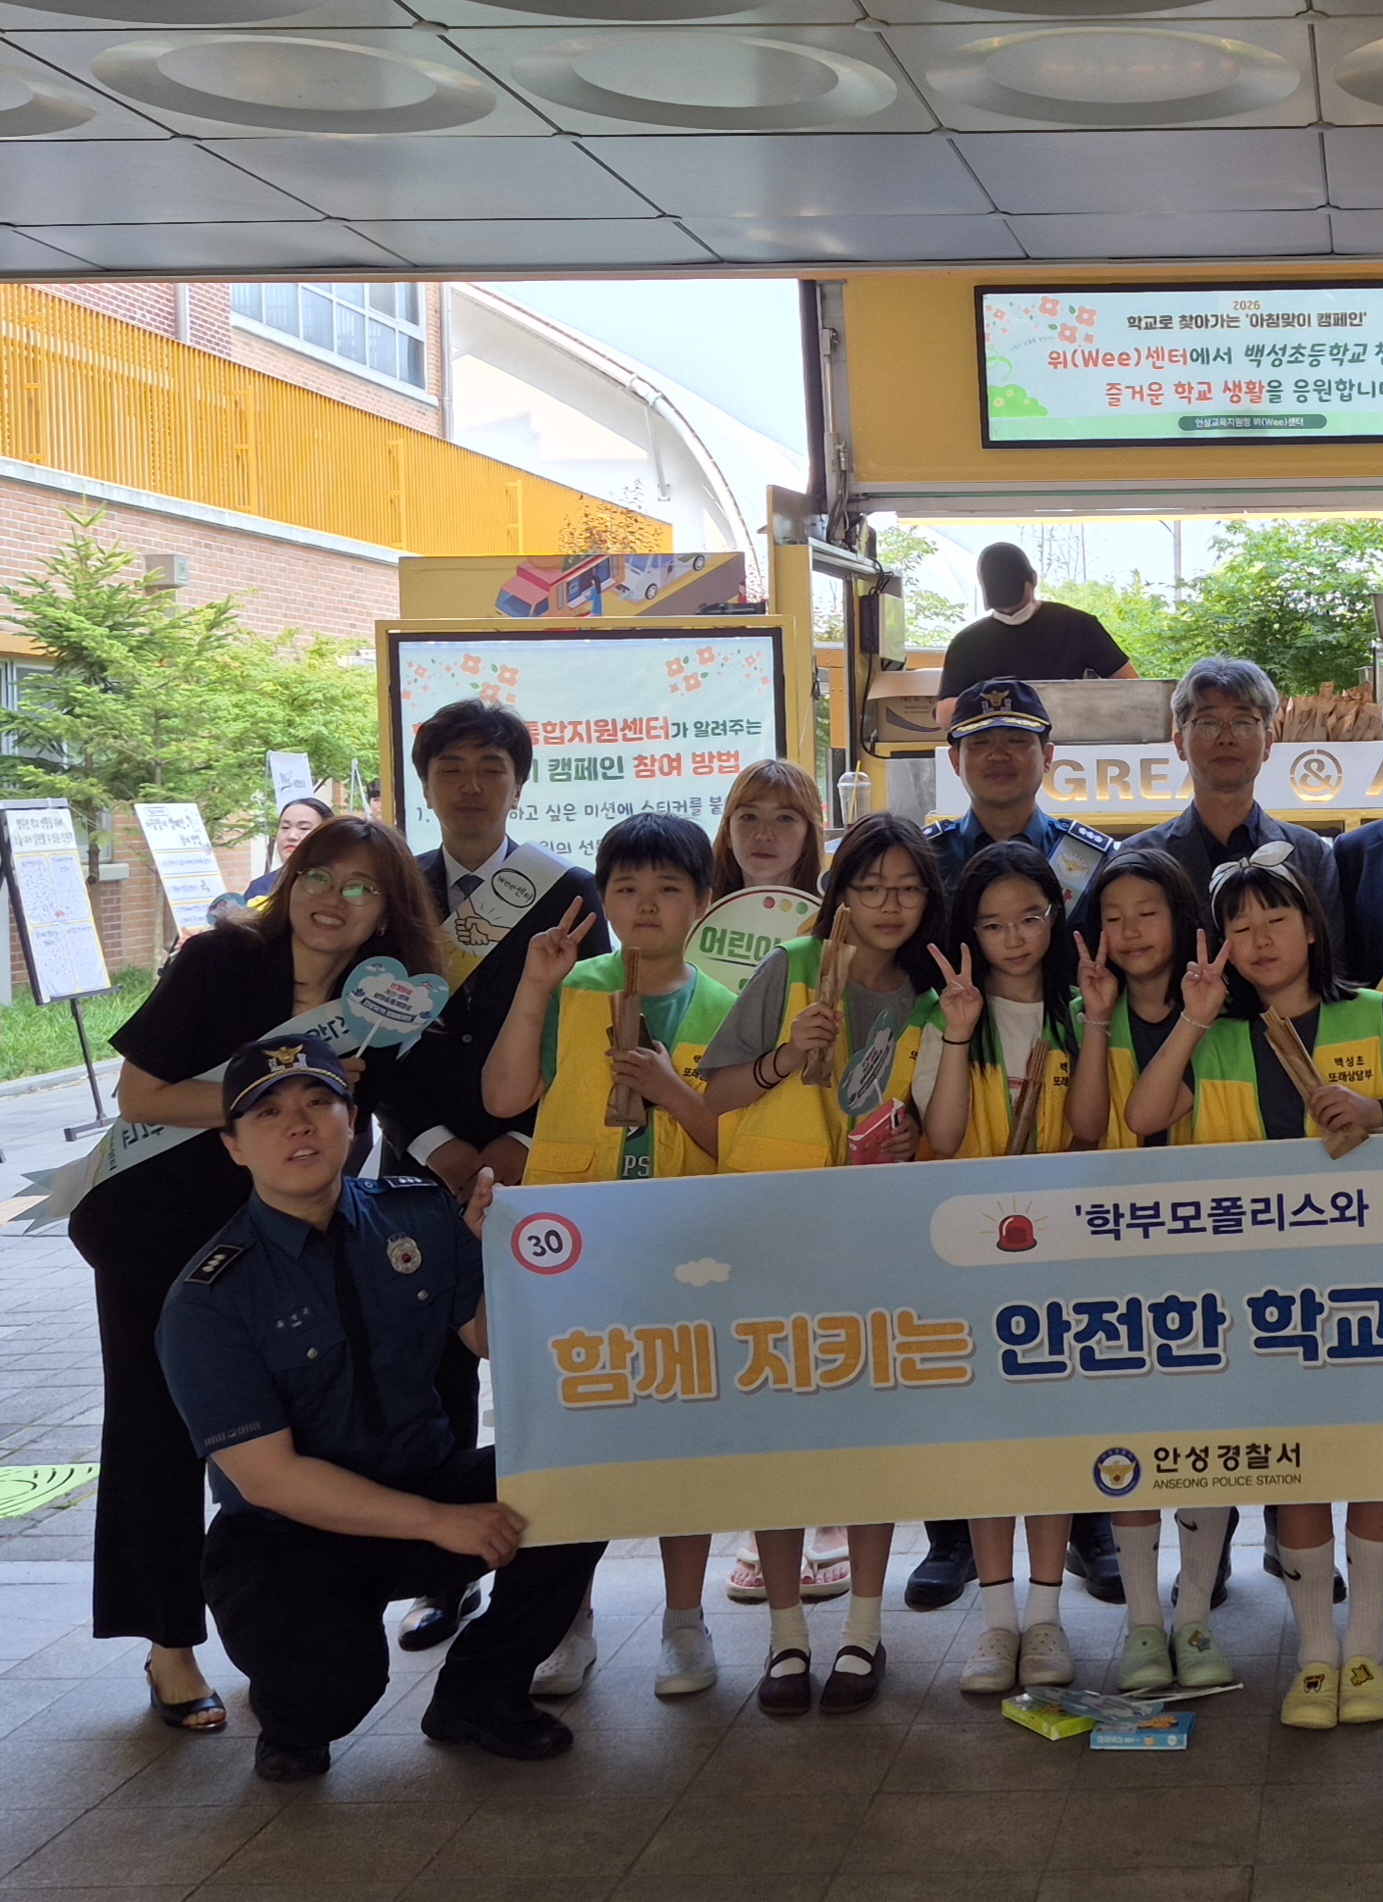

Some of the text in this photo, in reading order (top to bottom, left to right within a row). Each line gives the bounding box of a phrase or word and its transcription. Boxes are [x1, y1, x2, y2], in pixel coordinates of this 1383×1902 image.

[1232, 301, 1261, 311] 2026
[1126, 312, 1367, 330] 학교로 찾아가는 '아침맞이 캠페인'
[1047, 345, 1233, 370] 위(Wee)센터에서
[1244, 342, 1368, 367] 백성초등학교
[1104, 382, 1165, 408] 즐거운
[1172, 379, 1214, 402] 학교
[1222, 378, 1285, 404] 생활을
[693, 718, 762, 738] 알려주는
[547, 755, 625, 783] 캠페인
[632, 751, 683, 779] 참여
[691, 750, 741, 776] 방법
[545, 803, 578, 822] 싶은
[583, 801, 634, 821] 미션에
[1328, 1068, 1373, 1083] 또래상담부
[1074, 1189, 1370, 1242] '학부모폴리스와
[526, 1228, 564, 1259] 30
[550, 1320, 713, 1406] 함께
[734, 1311, 972, 1392] 지키는
[997, 1292, 1225, 1378] 안전한
[1153, 1442, 1301, 1473] 안성경찰서
[1152, 1474, 1302, 1490] ANSEONG POLICE STATION
